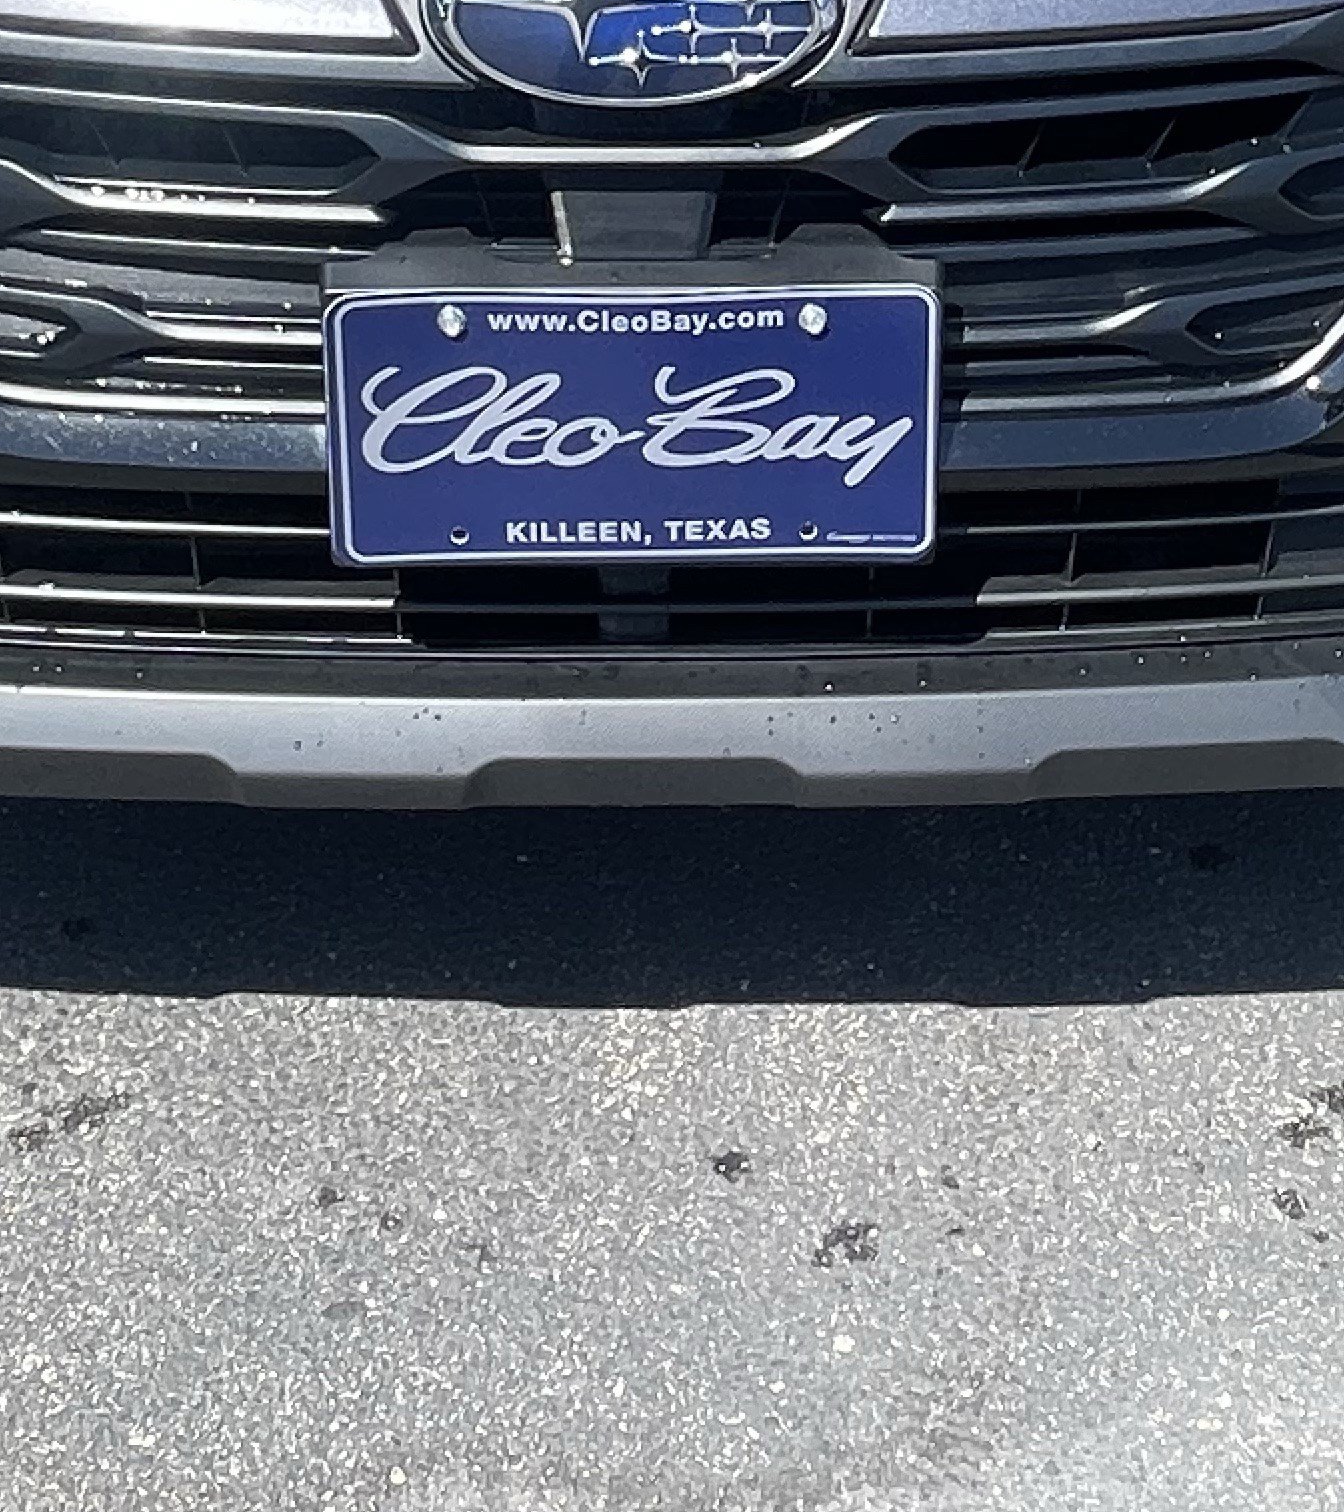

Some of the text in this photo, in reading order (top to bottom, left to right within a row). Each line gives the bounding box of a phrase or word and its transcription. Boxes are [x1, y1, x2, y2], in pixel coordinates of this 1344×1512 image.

[486, 308, 785, 336] www.CleoBay.com
[360, 366, 914, 488] Cleo Bay
[505, 518, 772, 546] KILLEEN, TEXAS
